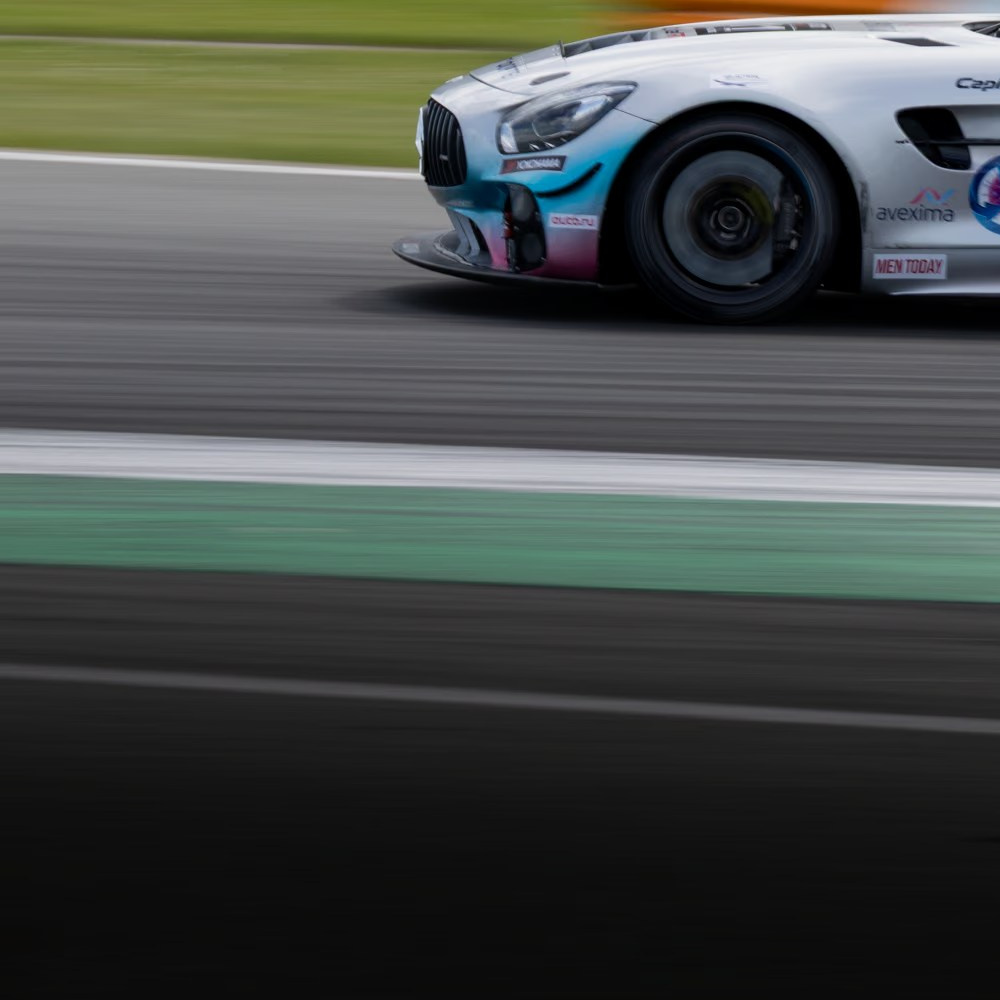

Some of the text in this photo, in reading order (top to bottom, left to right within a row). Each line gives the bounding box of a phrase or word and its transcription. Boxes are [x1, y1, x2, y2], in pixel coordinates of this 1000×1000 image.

[876, 204, 955, 222] avexima
[875, 258, 944, 274] MEN TODAY
